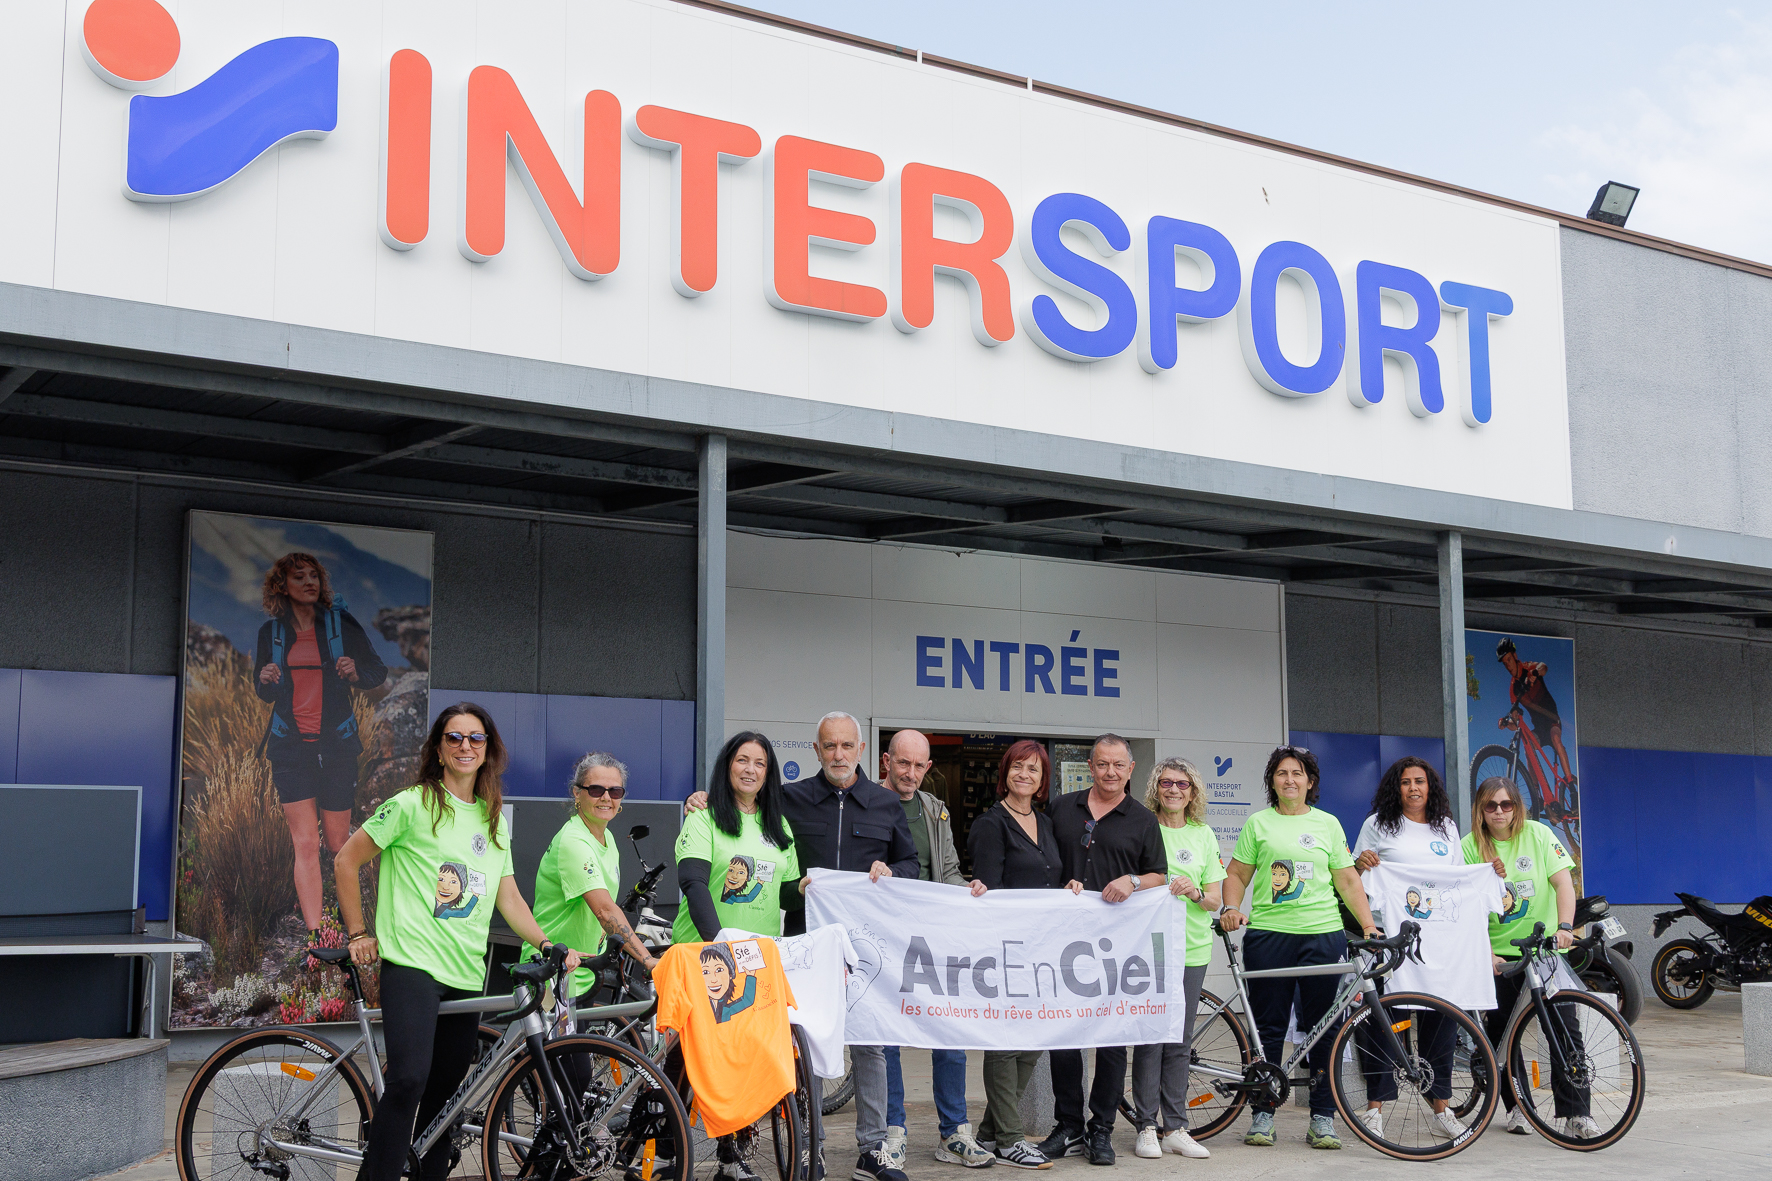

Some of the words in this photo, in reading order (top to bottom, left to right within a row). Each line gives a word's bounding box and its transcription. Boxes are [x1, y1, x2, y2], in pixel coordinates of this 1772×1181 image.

[382, 48, 1514, 426] INTERSPORT
[916, 629, 1120, 698] ENTRÉE
[770, 740, 781, 748] OS
[782, 740, 815, 749] SERVICE
[900, 998, 922, 1016] les
[927, 1001, 979, 1019] couleurs
[983, 1002, 1000, 1019] du
[1004, 1004, 1033, 1020] rêve
[1037, 1003, 1072, 1020] dans
[1076, 1008, 1093, 1018] un
[1095, 1000, 1113, 1018] ciel
[1115, 998, 1167, 1016] d'enfant
[302, 1040, 333, 1059] MAVIC
[633, 1064, 662, 1090] MAVIC
[1453, 1128, 1474, 1148] MAVIC
